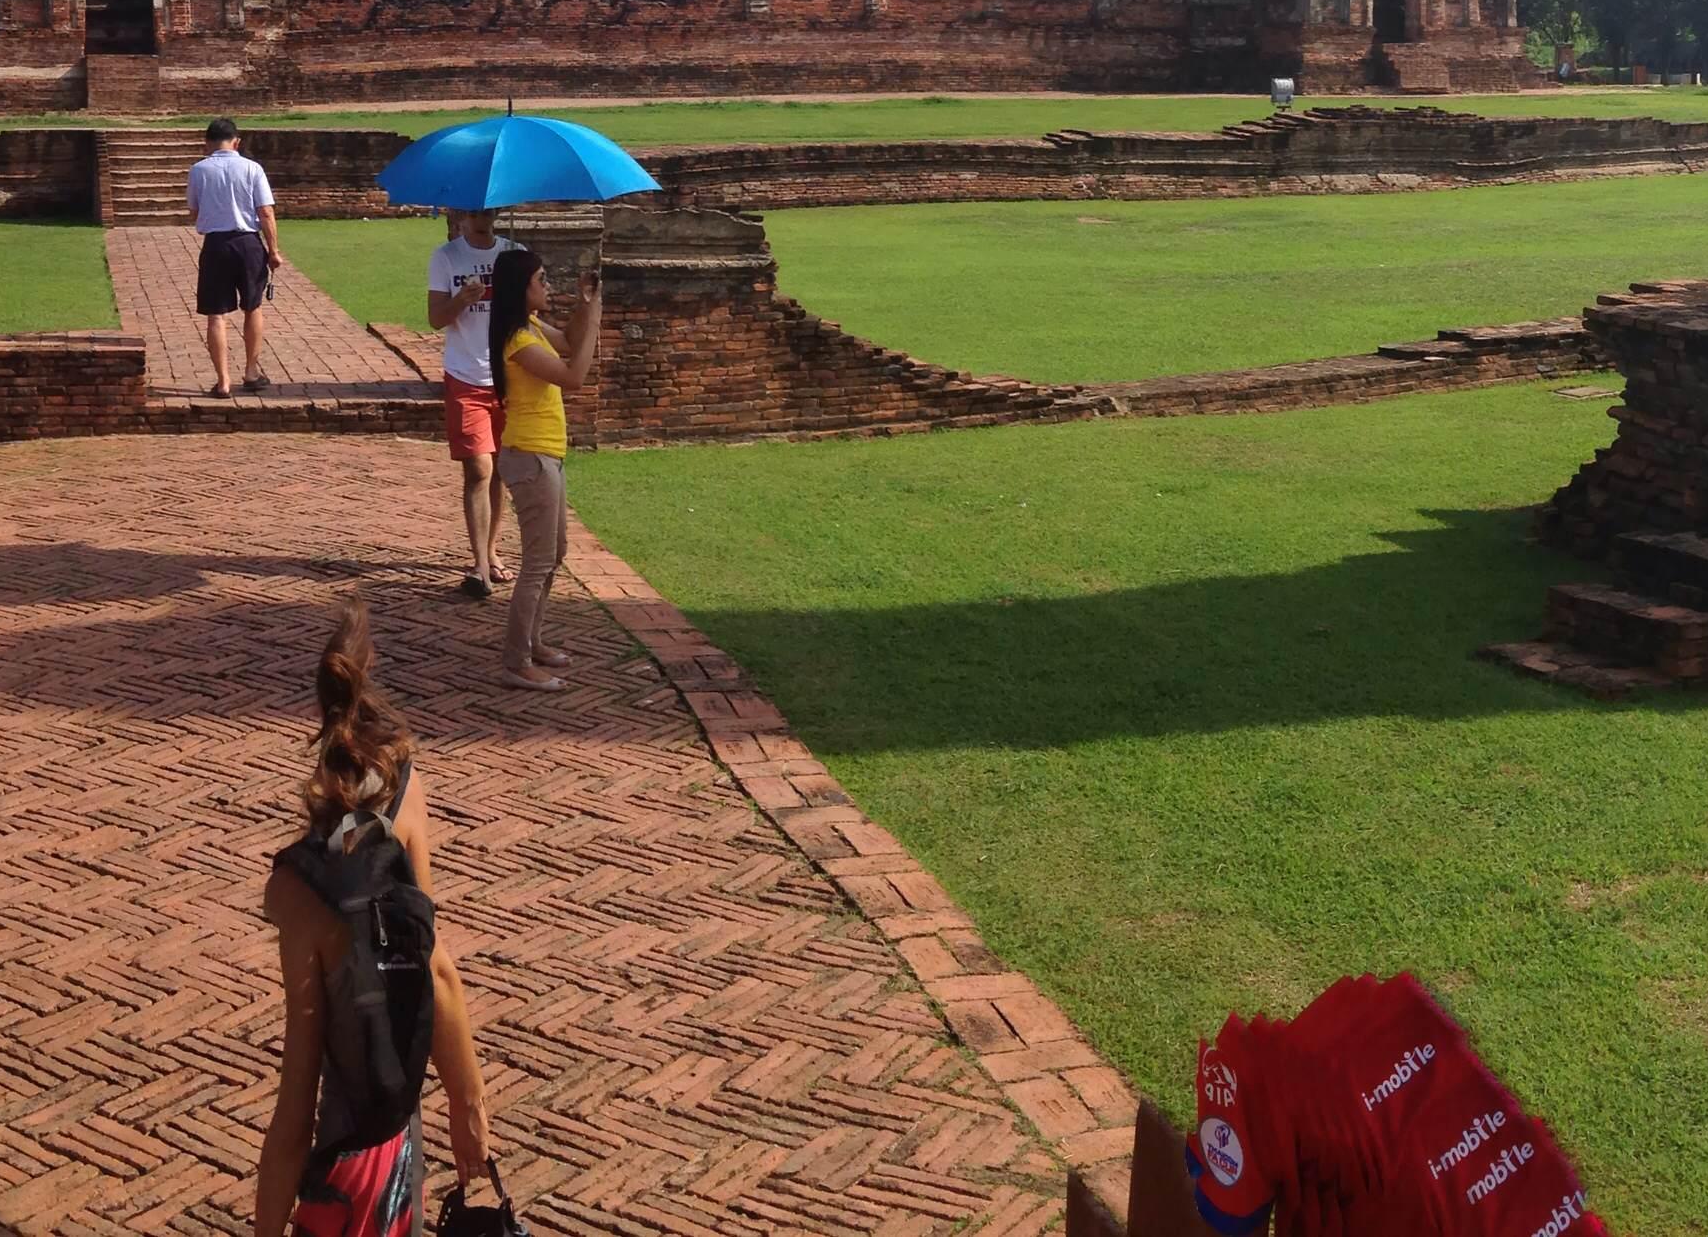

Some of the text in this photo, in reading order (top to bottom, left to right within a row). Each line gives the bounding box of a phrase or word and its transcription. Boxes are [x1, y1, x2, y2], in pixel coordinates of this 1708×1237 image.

[1361, 1043, 1436, 1111] i-mobile
[1427, 1110, 1507, 1180] i-mobile
[1466, 1141, 1535, 1205] mobile
[1530, 1189, 1588, 1237] mobil
